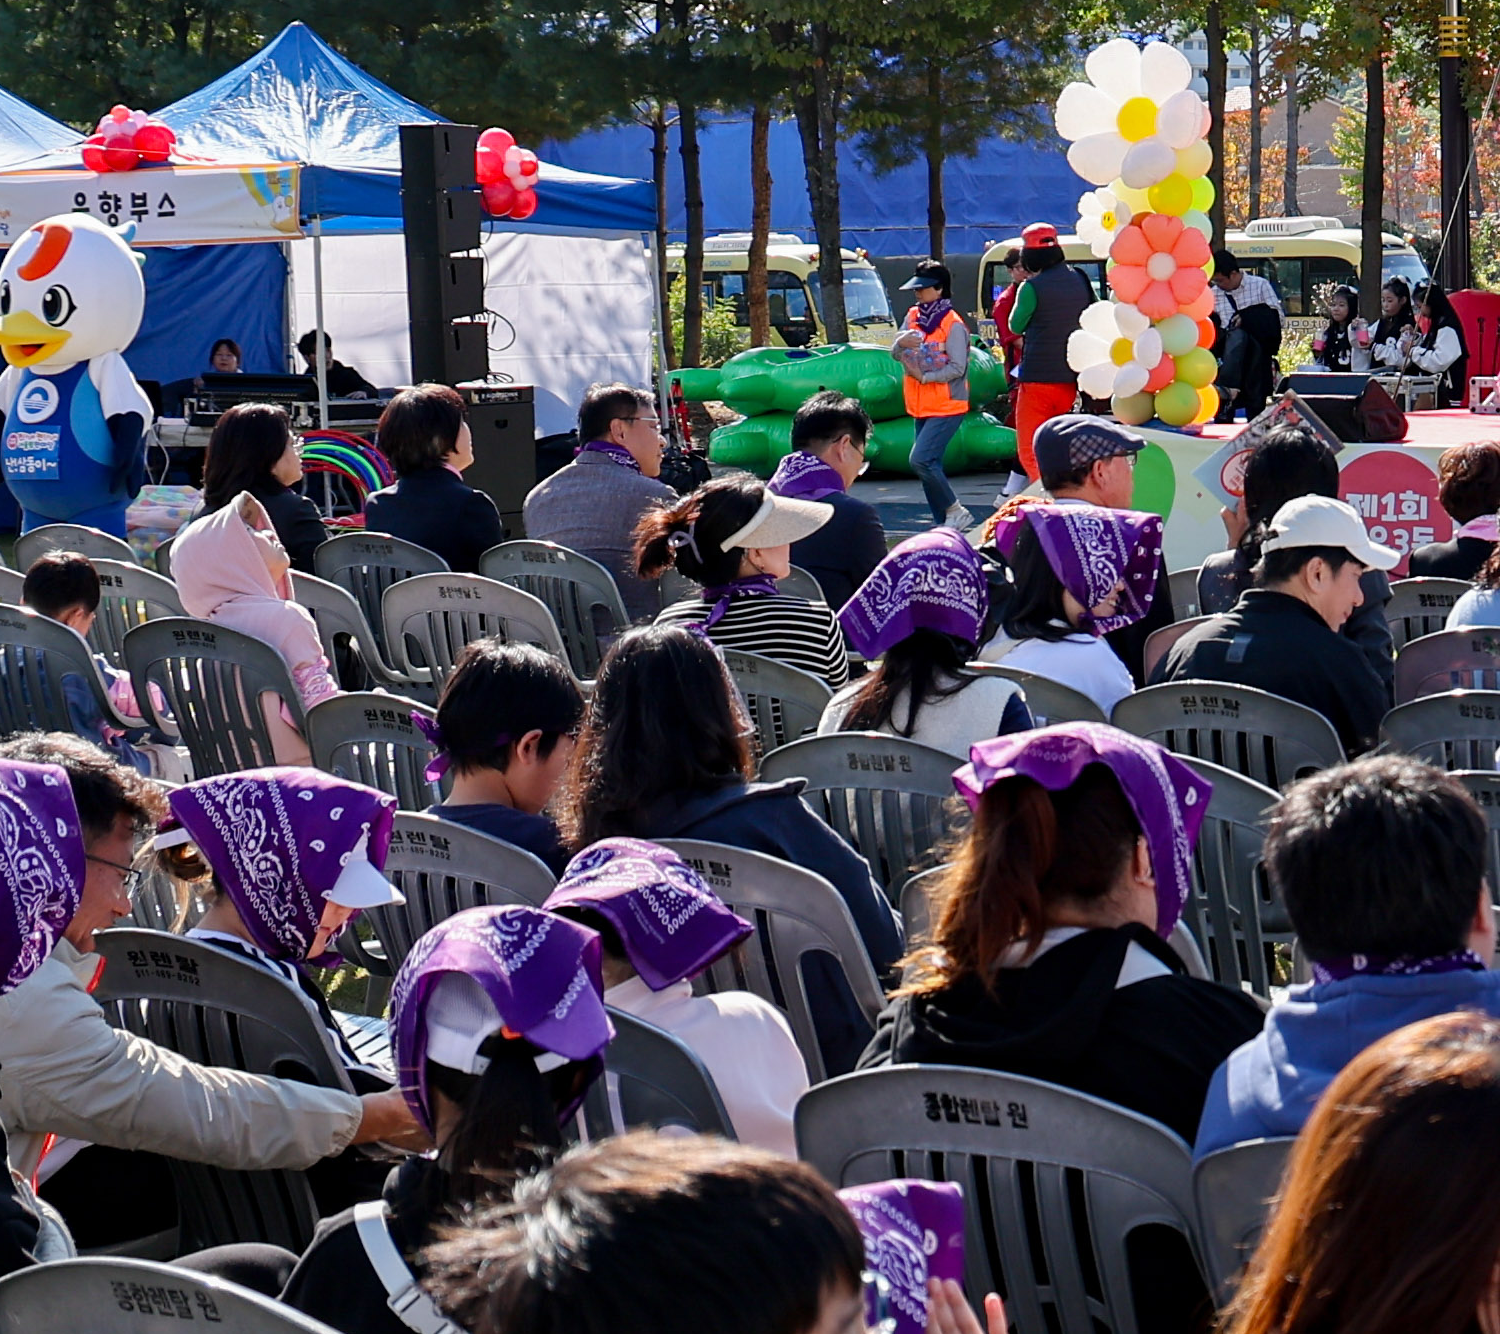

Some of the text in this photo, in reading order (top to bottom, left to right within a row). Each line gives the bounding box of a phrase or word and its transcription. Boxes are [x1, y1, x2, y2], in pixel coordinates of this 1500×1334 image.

[898, 754, 913, 774] 원
[389, 846, 452, 861] 011-489-8252
[134, 969, 201, 988] 011-489-8252
[922, 1091, 1029, 1130] 종합렌탈 원
[110, 1279, 222, 1323] 종합렌탈 원
